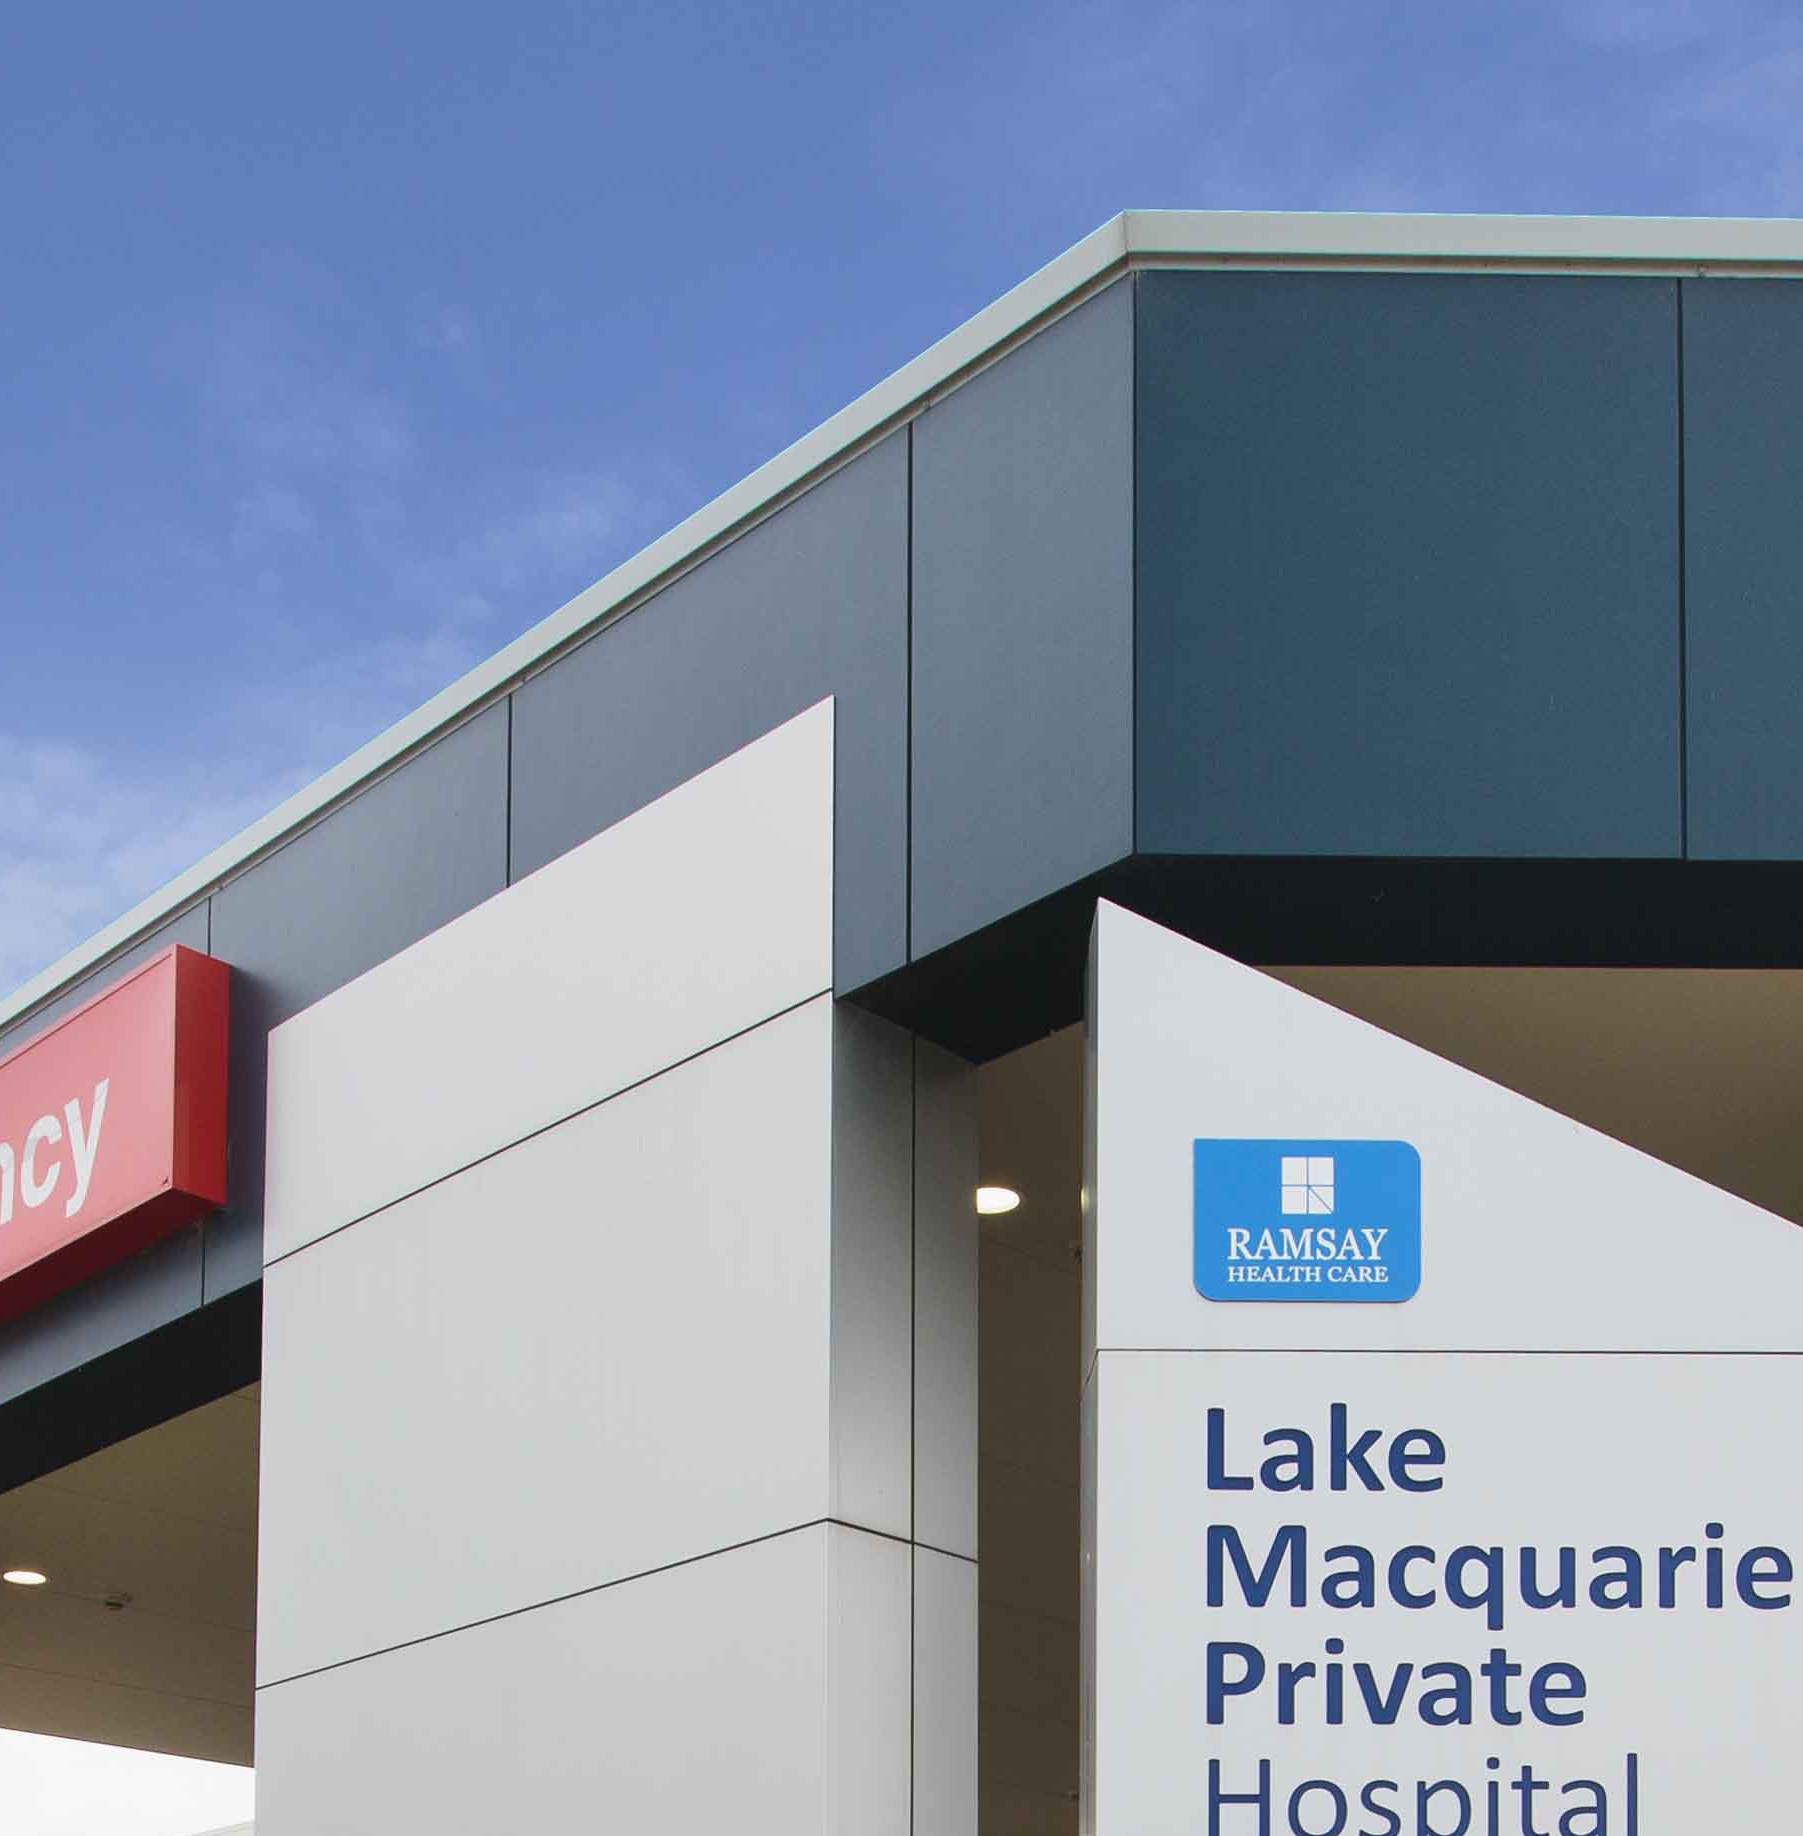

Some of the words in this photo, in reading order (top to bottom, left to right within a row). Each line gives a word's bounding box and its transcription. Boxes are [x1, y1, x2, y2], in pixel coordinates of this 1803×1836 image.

[1227, 1227, 1389, 1260] RAMSAY
[1227, 1266, 1321, 1282] HEALTH
[1327, 1266, 1389, 1282] CARE
[1206, 1402, 1446, 1493] Lake
[1206, 1521, 1794, 1632] Macquarie
[1206, 1637, 1587, 1727] Private
